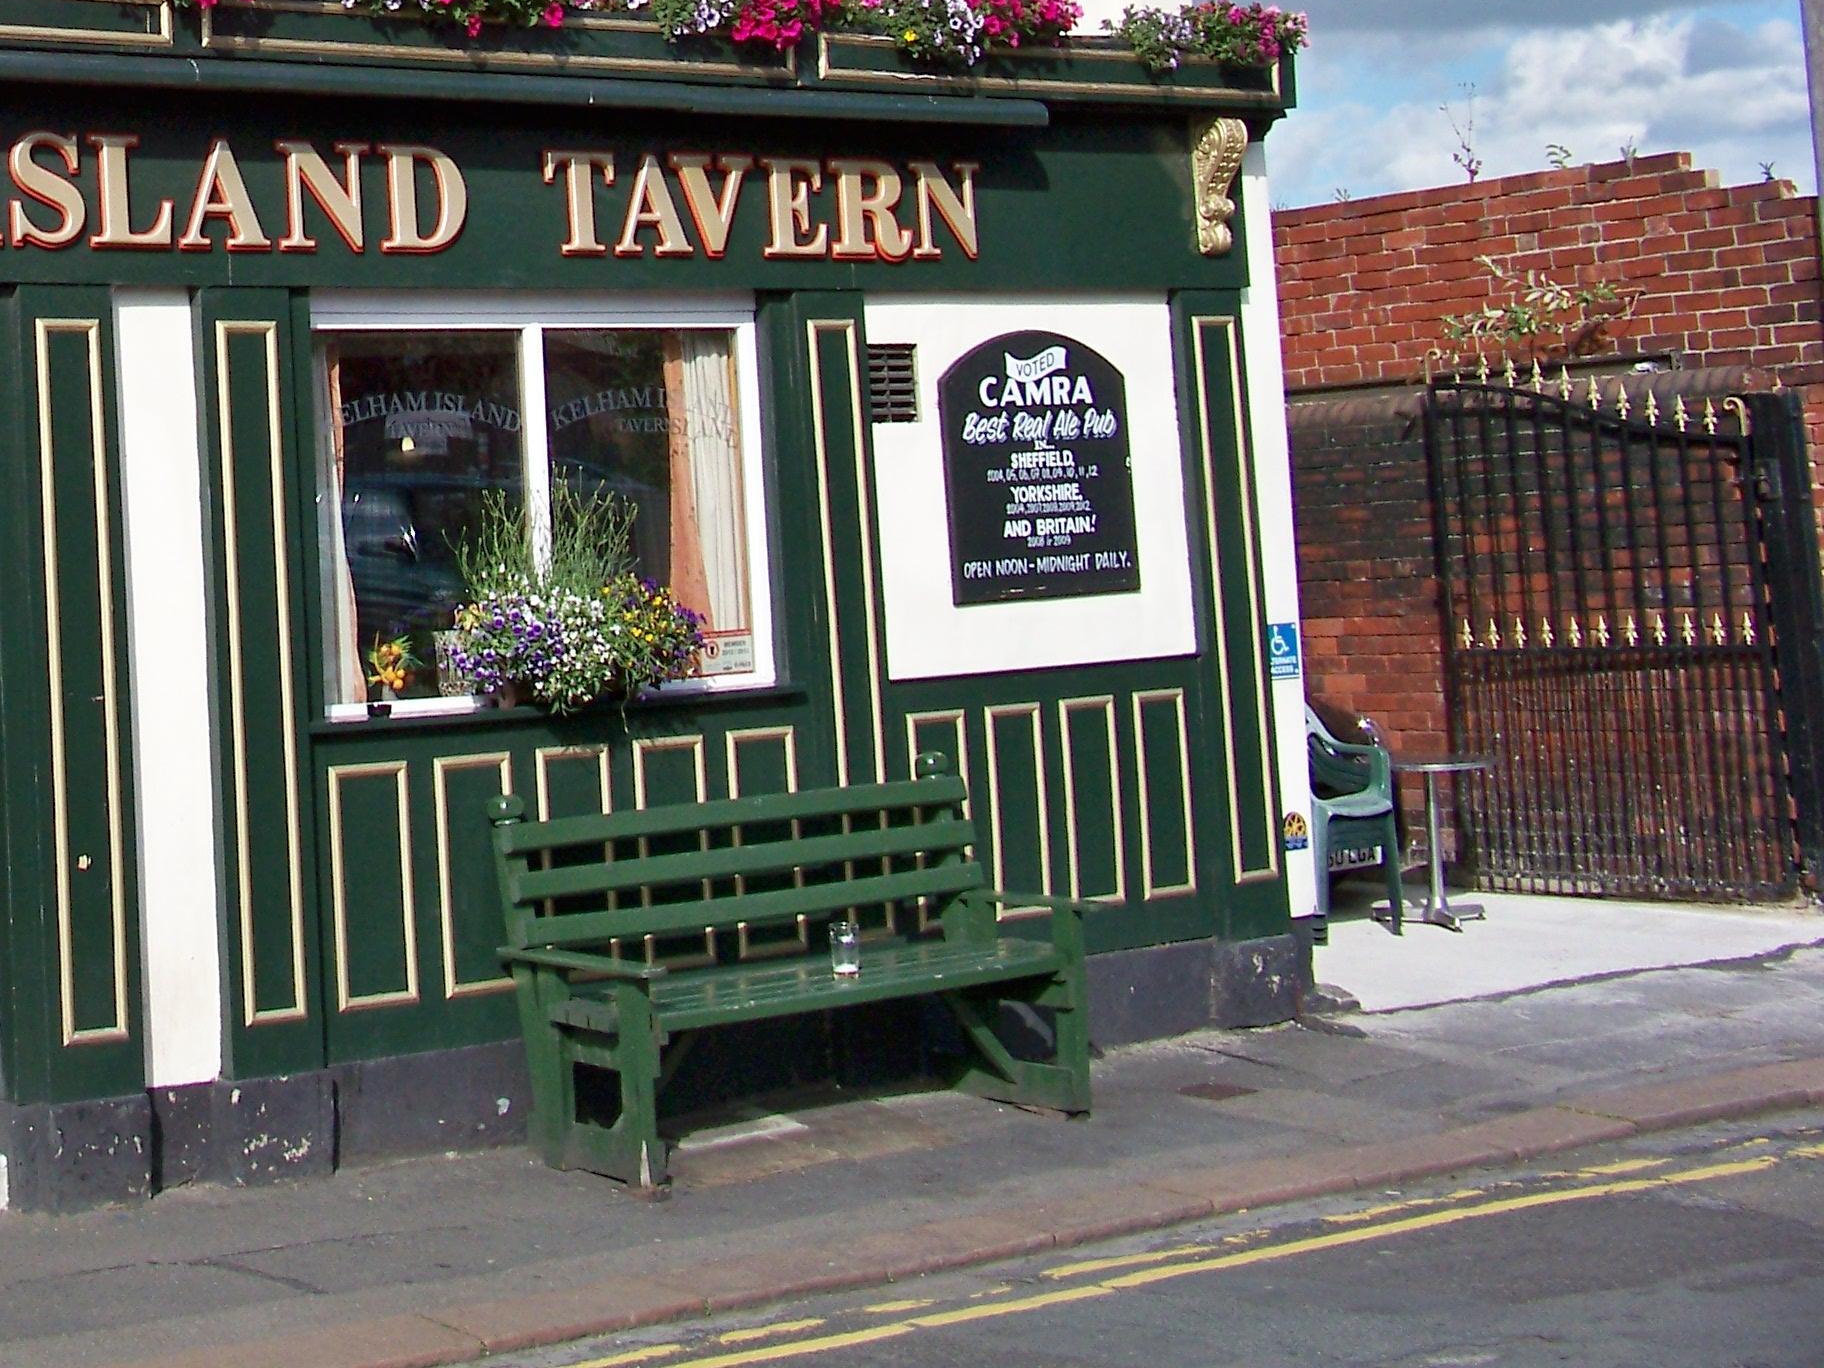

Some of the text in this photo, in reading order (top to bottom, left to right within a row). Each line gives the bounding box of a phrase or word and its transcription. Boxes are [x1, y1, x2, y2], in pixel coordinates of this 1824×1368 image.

[541, 147, 981, 263] TAVERN
[1015, 352, 1056, 377] VOTED
[551, 386, 652, 431] KELHAM
[978, 375, 1094, 408] CAMRA
[434, 391, 522, 433] ISLAND
[962, 407, 1118, 445] Best Real Ale Pub
[1003, 514, 1096, 538] AND BRITAIN!
[964, 559, 992, 579] OPEN
